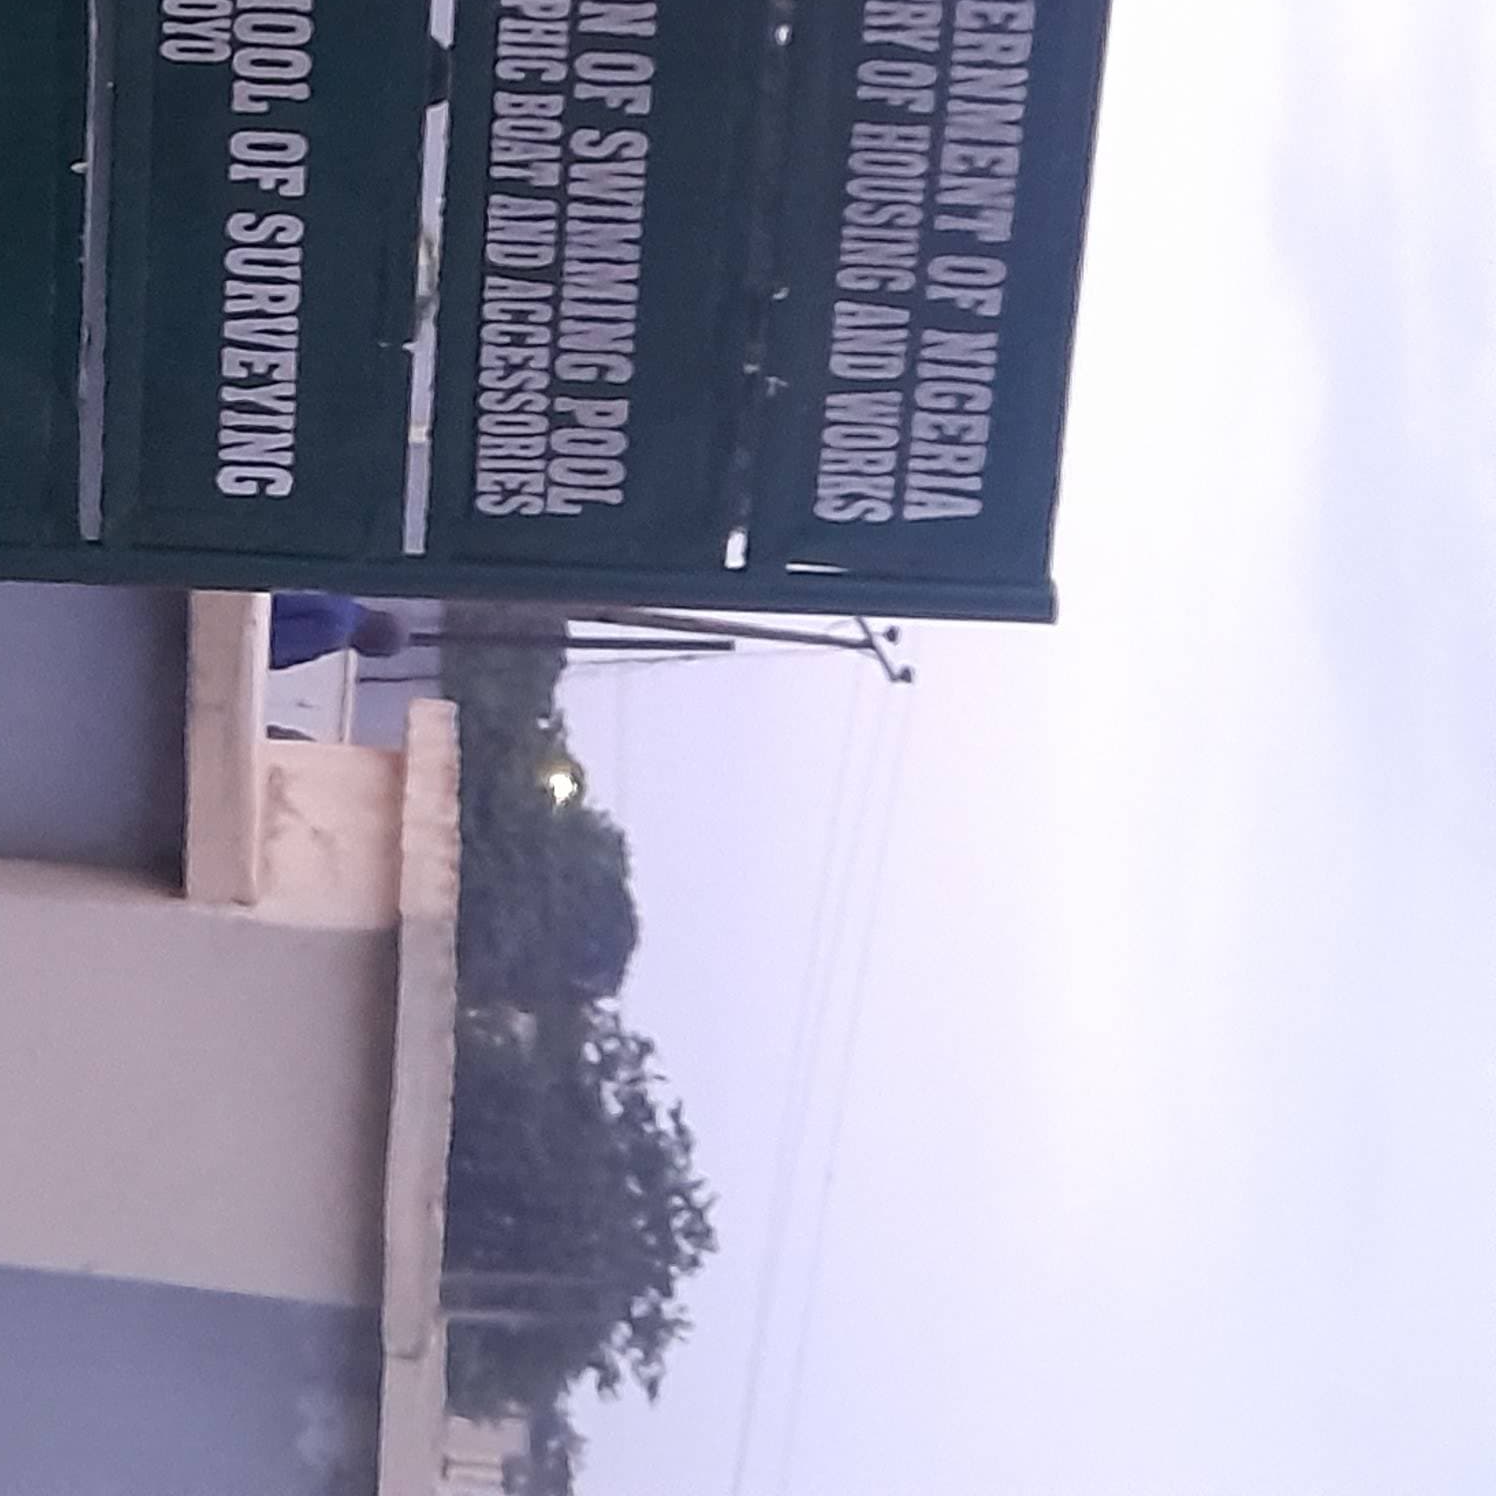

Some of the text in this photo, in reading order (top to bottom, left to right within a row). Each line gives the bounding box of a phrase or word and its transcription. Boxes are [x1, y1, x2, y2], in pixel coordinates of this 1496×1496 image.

[573, 52, 654, 114] OF
[856, 60, 938, 113] OF
[229, 130, 307, 197] OF
[490, 92, 565, 186] BOAT
[485, 195, 559, 267] AND
[554, 128, 649, 384] SWIMMING
[835, 123, 931, 292] HOUSING
[925, 254, 1007, 317] OF
[216, 212, 304, 497] SURVEYING
[829, 301, 911, 378] AND
[476, 276, 559, 516] ACCESSORIES
[902, 327, 999, 522] NIGERIA
[546, 396, 628, 514] POOL
[813, 390, 903, 522] WORKS
